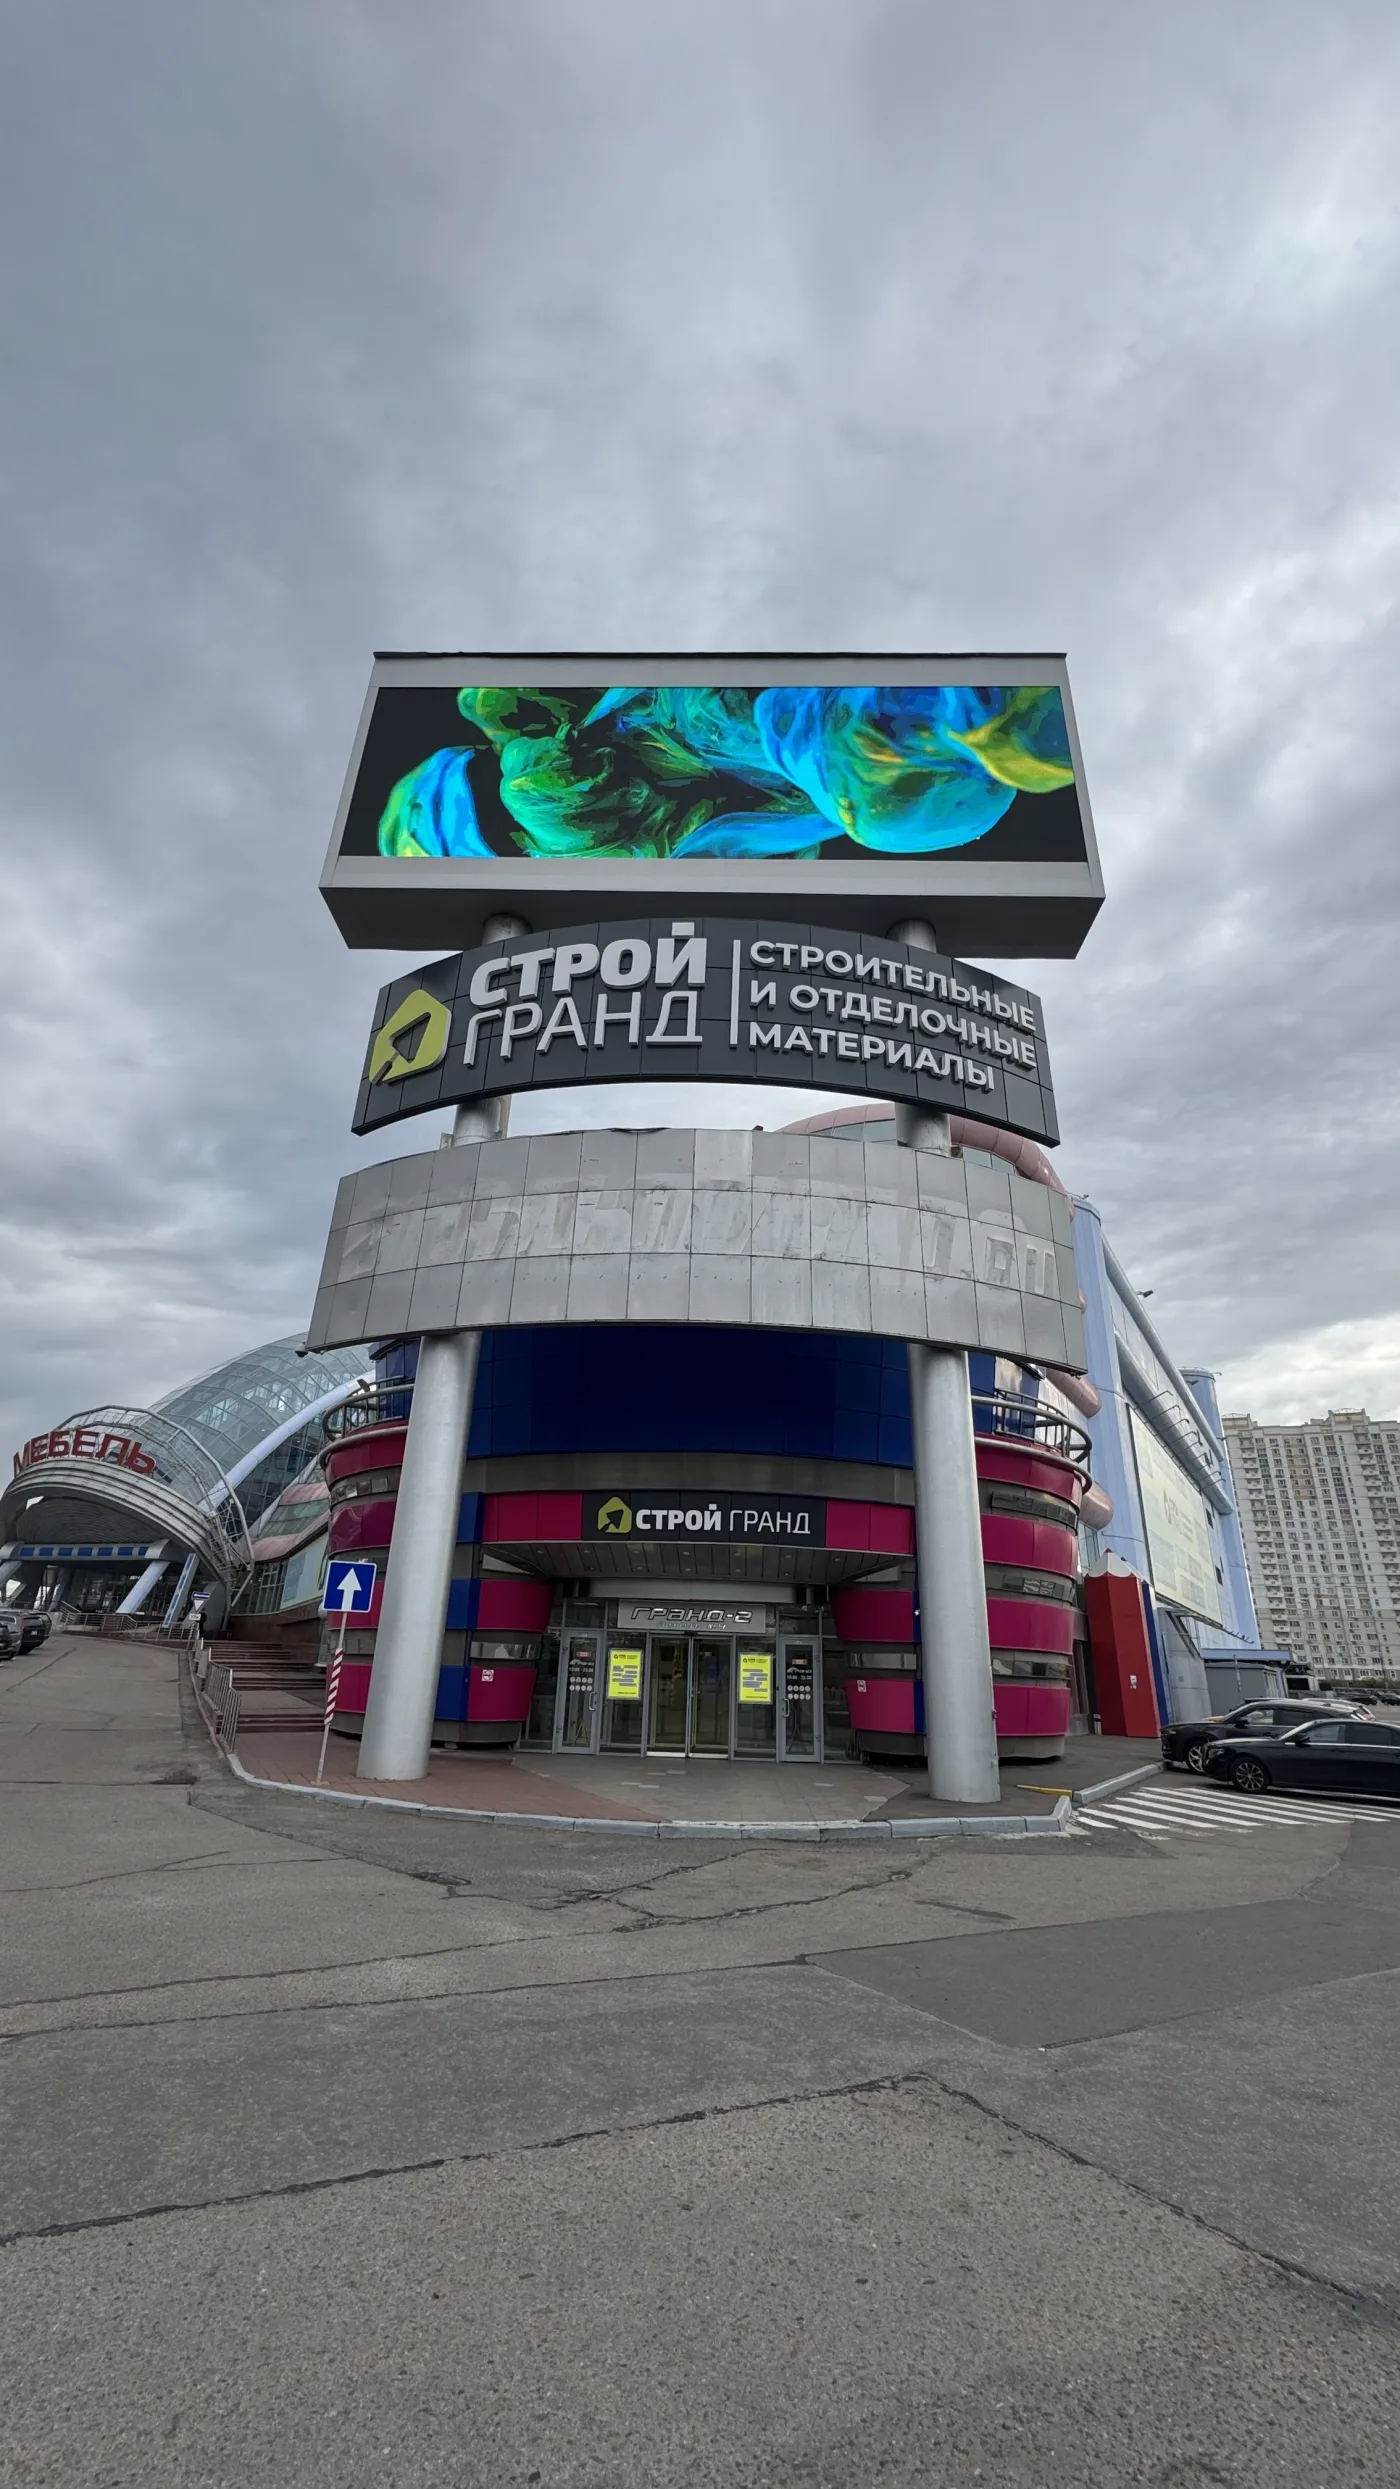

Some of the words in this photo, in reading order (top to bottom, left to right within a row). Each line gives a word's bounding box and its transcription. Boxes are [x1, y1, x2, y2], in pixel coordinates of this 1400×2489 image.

[469, 921, 708, 1009] СТРОЙ
[749, 940, 1037, 1033] СТРОИТЕЛЬНЫЕ
[462, 990, 703, 1068] ГРАНД
[748, 1021, 995, 1093] МАТЕРИАЛЫ
[749, 979, 777, 1009] И
[788, 984, 1038, 1071] ОТДЕЛОЧНЫЕ
[13, 1429, 157, 1479] МЕБЕЛЬ
[635, 1503, 722, 1532] СТРОЙ
[729, 1509, 812, 1535] ГРАНД
